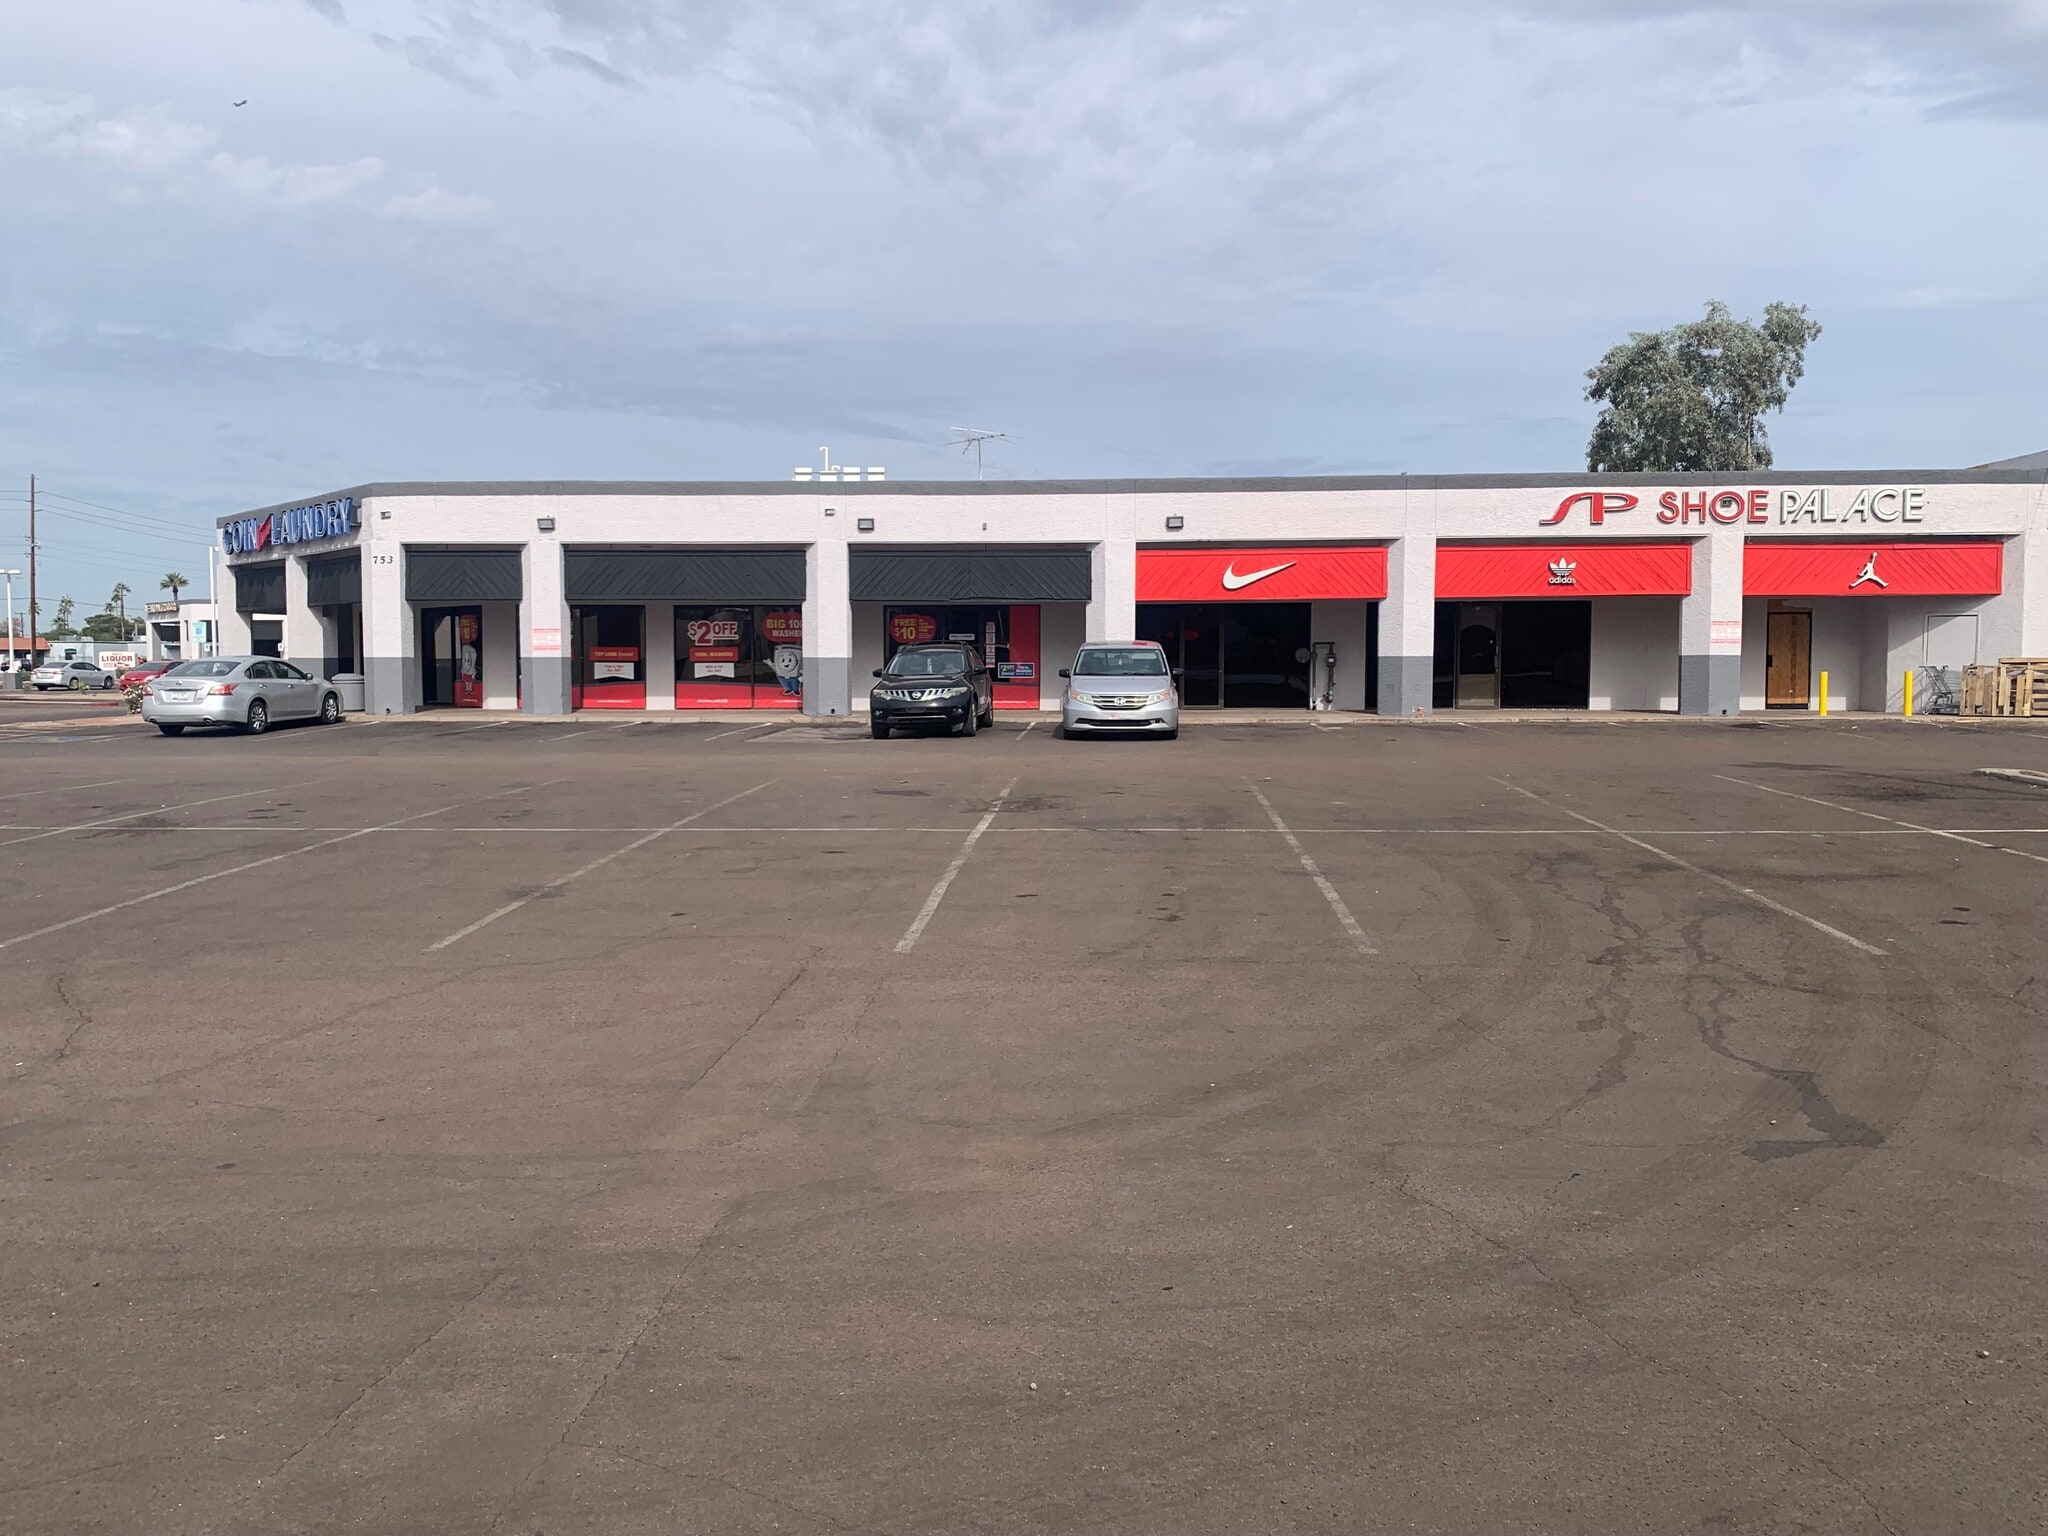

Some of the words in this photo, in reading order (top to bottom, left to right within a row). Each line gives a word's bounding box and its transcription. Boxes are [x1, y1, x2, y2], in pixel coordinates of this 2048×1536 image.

[1657, 490, 1769, 524] SHOE
[1780, 488, 1925, 524] PALACE
[223, 517, 258, 555] COIN
[271, 497, 353, 546] LAUNDRY
[373, 556, 393, 564] 753
[1548, 576, 1576, 585] adidas
[712, 622, 738, 635] OFF
[766, 619, 786, 629] BIG
[895, 627, 916, 639] $10
